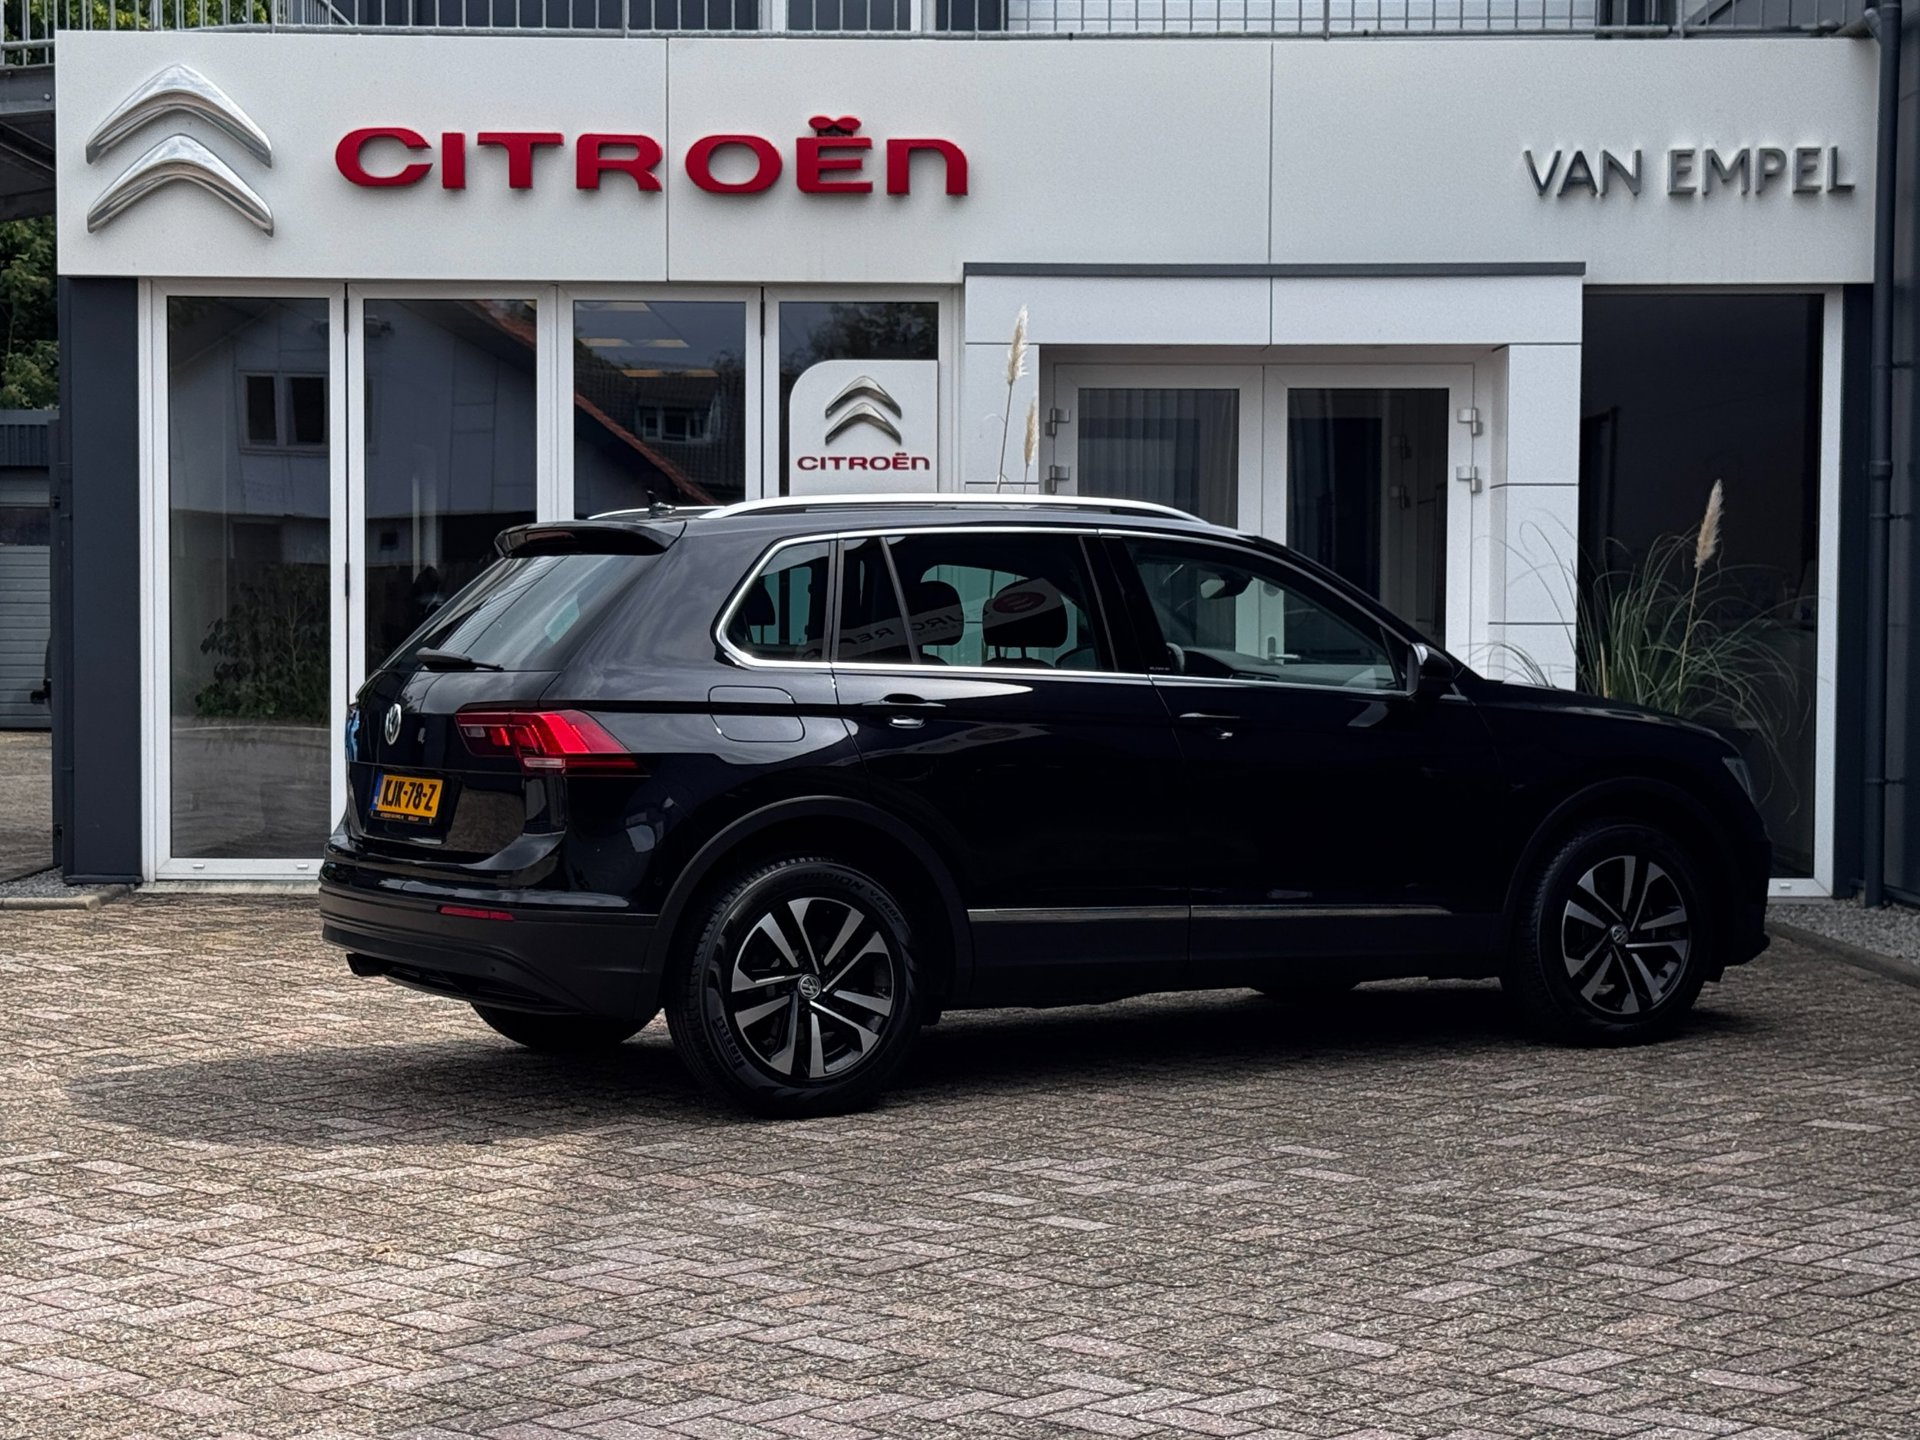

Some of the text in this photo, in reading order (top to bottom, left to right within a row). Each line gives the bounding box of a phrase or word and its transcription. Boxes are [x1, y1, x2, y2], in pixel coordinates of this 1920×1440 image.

[1522, 146, 1856, 198] VAN EMPEL
[382, 780, 437, 811] KJK-78-Z
